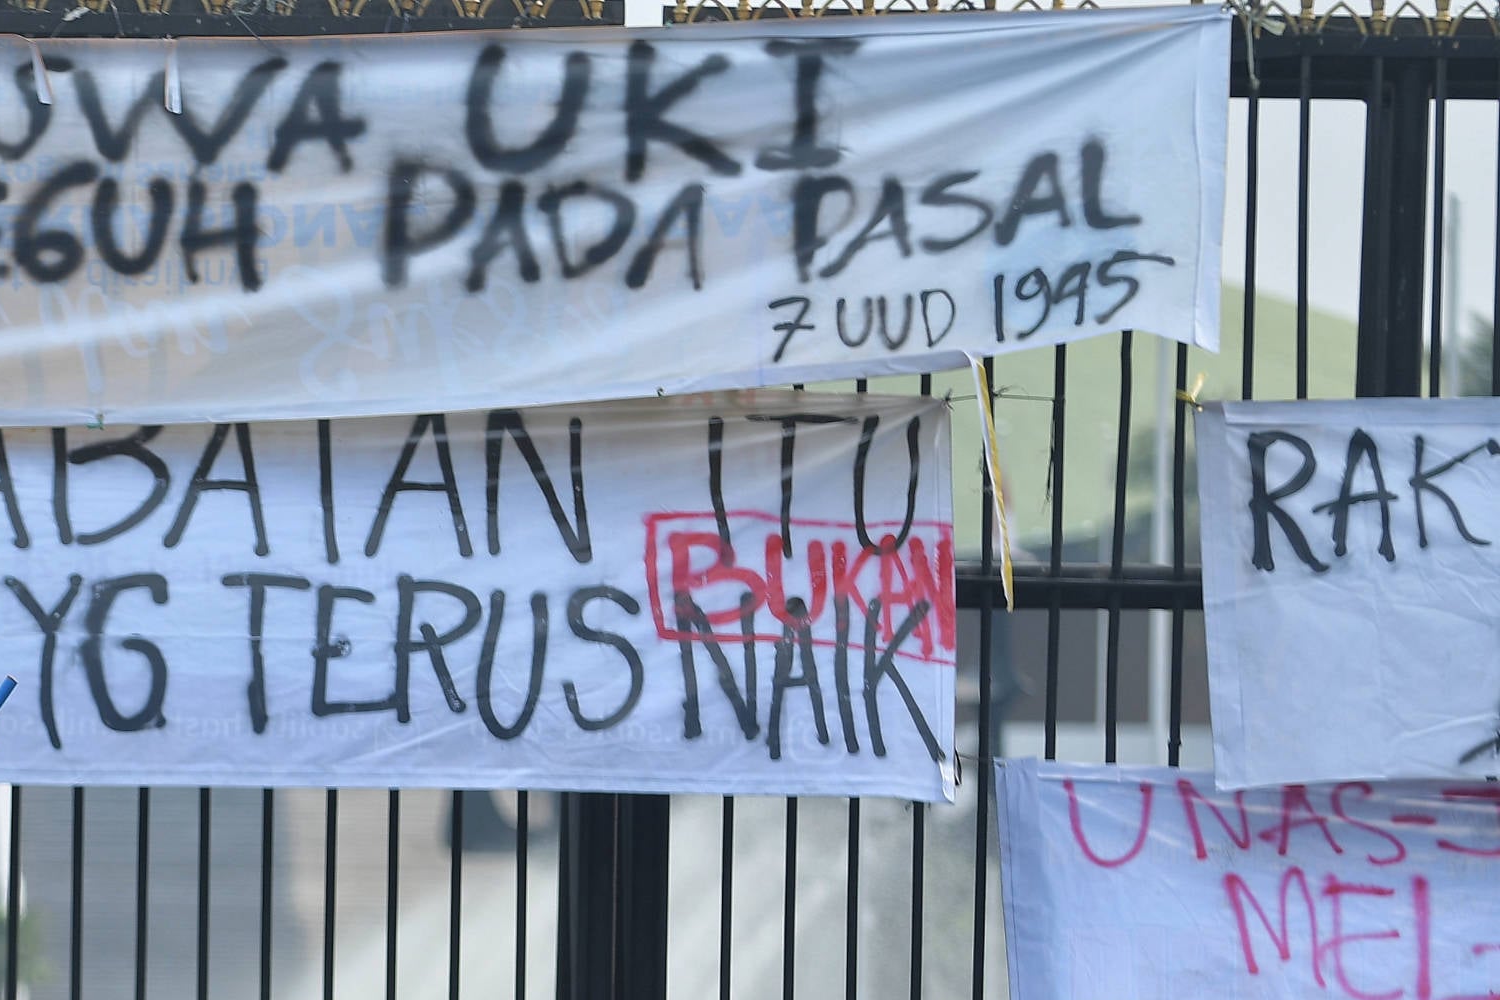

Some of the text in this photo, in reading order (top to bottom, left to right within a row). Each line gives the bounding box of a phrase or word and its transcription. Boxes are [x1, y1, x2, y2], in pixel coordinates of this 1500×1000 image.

[465, 38, 862, 182] UKI
[380, 155, 704, 292] PADA
[789, 135, 1143, 284] PASAL
[768, 294, 818, 363] 7
[836, 287, 957, 351] UUD
[708, 412, 922, 567] ITU
[1247, 428, 1500, 573] RAK
[5, 572, 170, 750] YG
[222, 572, 648, 742] TERUS
[673, 590, 946, 762] NAIK
[668, 531, 954, 659] BUKAN
